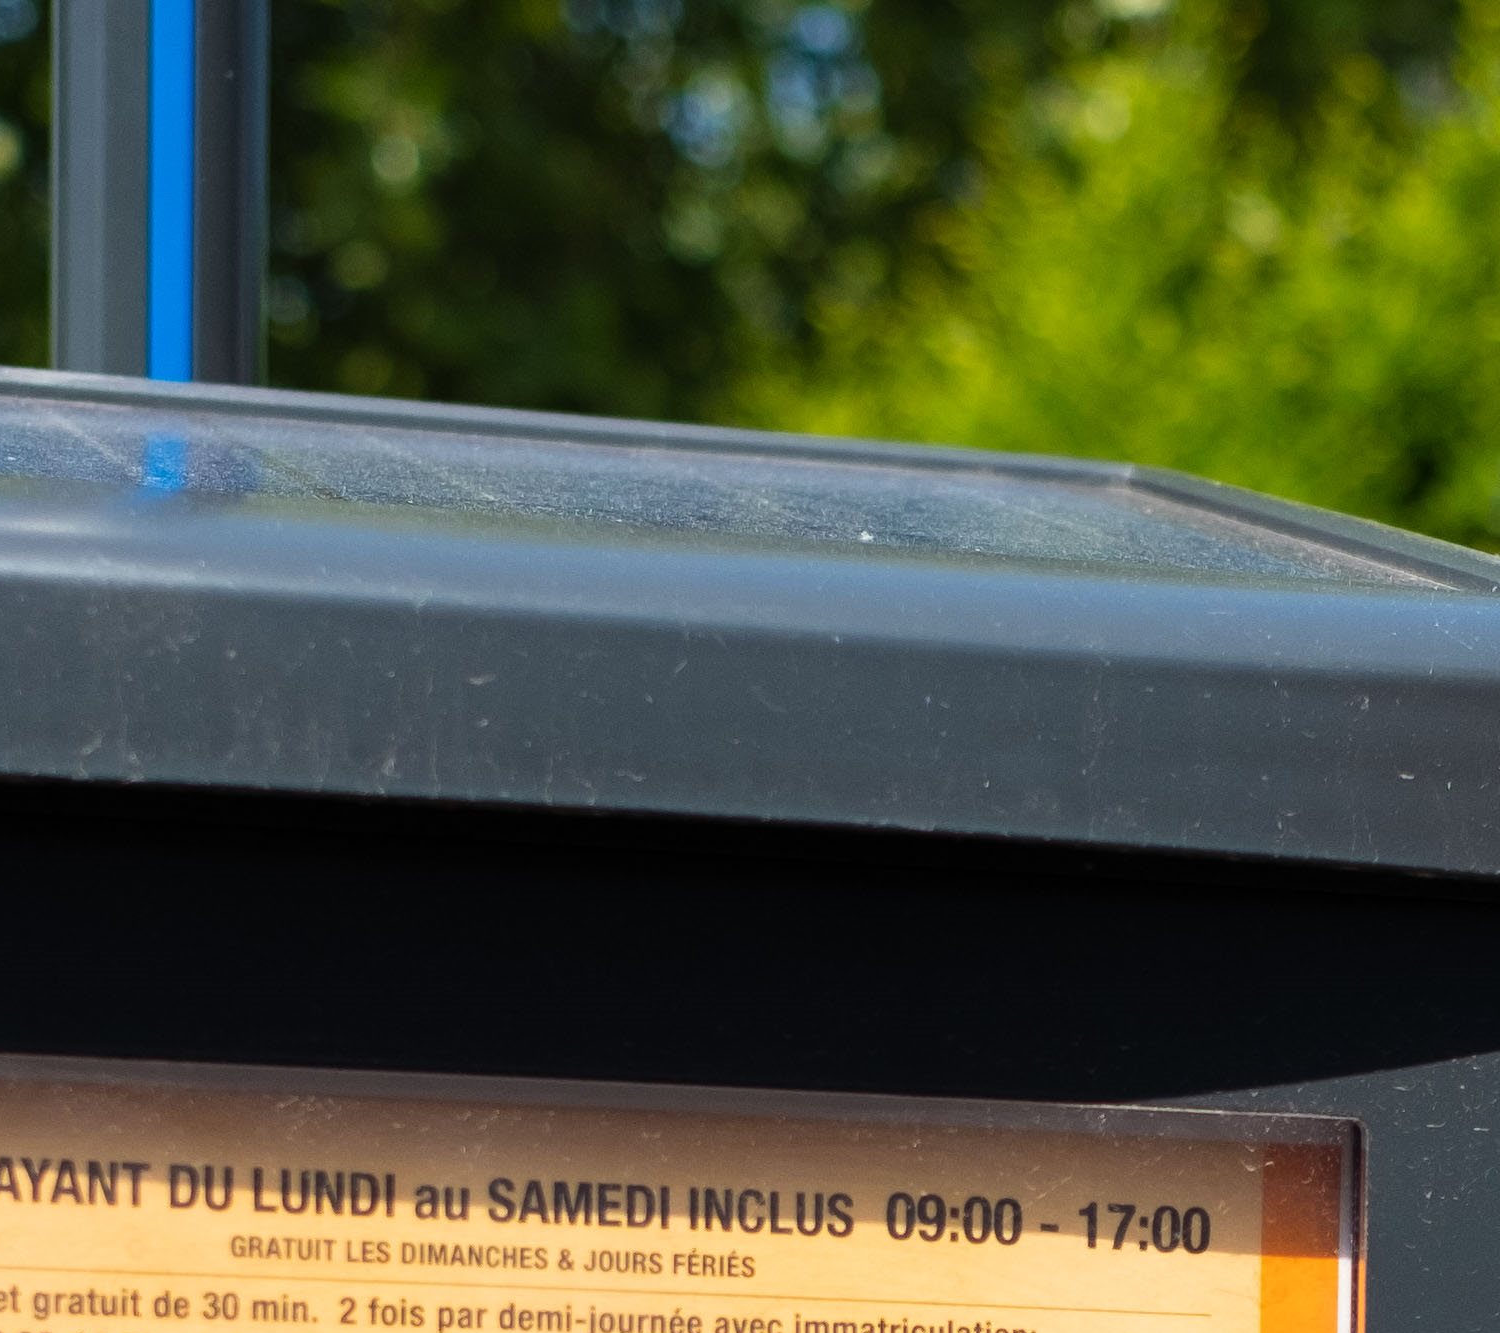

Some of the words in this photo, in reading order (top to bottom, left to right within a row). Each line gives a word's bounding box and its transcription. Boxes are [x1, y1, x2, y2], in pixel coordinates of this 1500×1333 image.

[169, 1163, 234, 1212] DU
[253, 1167, 396, 1218] LUNDI
[414, 1183, 470, 1220] au
[488, 1178, 670, 1230] SAMEDI
[689, 1187, 855, 1238] INCLUS
[886, 1191, 1023, 1246] 09:00
[1079, 1202, 1212, 1254] 17:00
[230, 1234, 335, 1262] GRATUIT
[347, 1240, 391, 1264] LES
[401, 1242, 548, 1270] DIMANCHES
[557, 1248, 575, 1271] &
[583, 1249, 663, 1275] JOURS
[672, 1248, 756, 1278] FÉRIÉS
[32, 1286, 141, 1320] gratuit
[154, 1290, 190, 1319] de
[202, 1292, 240, 1321] 30
[252, 1294, 320, 1324] min.
[339, 1297, 357, 1325] 2
[368, 1295, 425, 1327] fois
